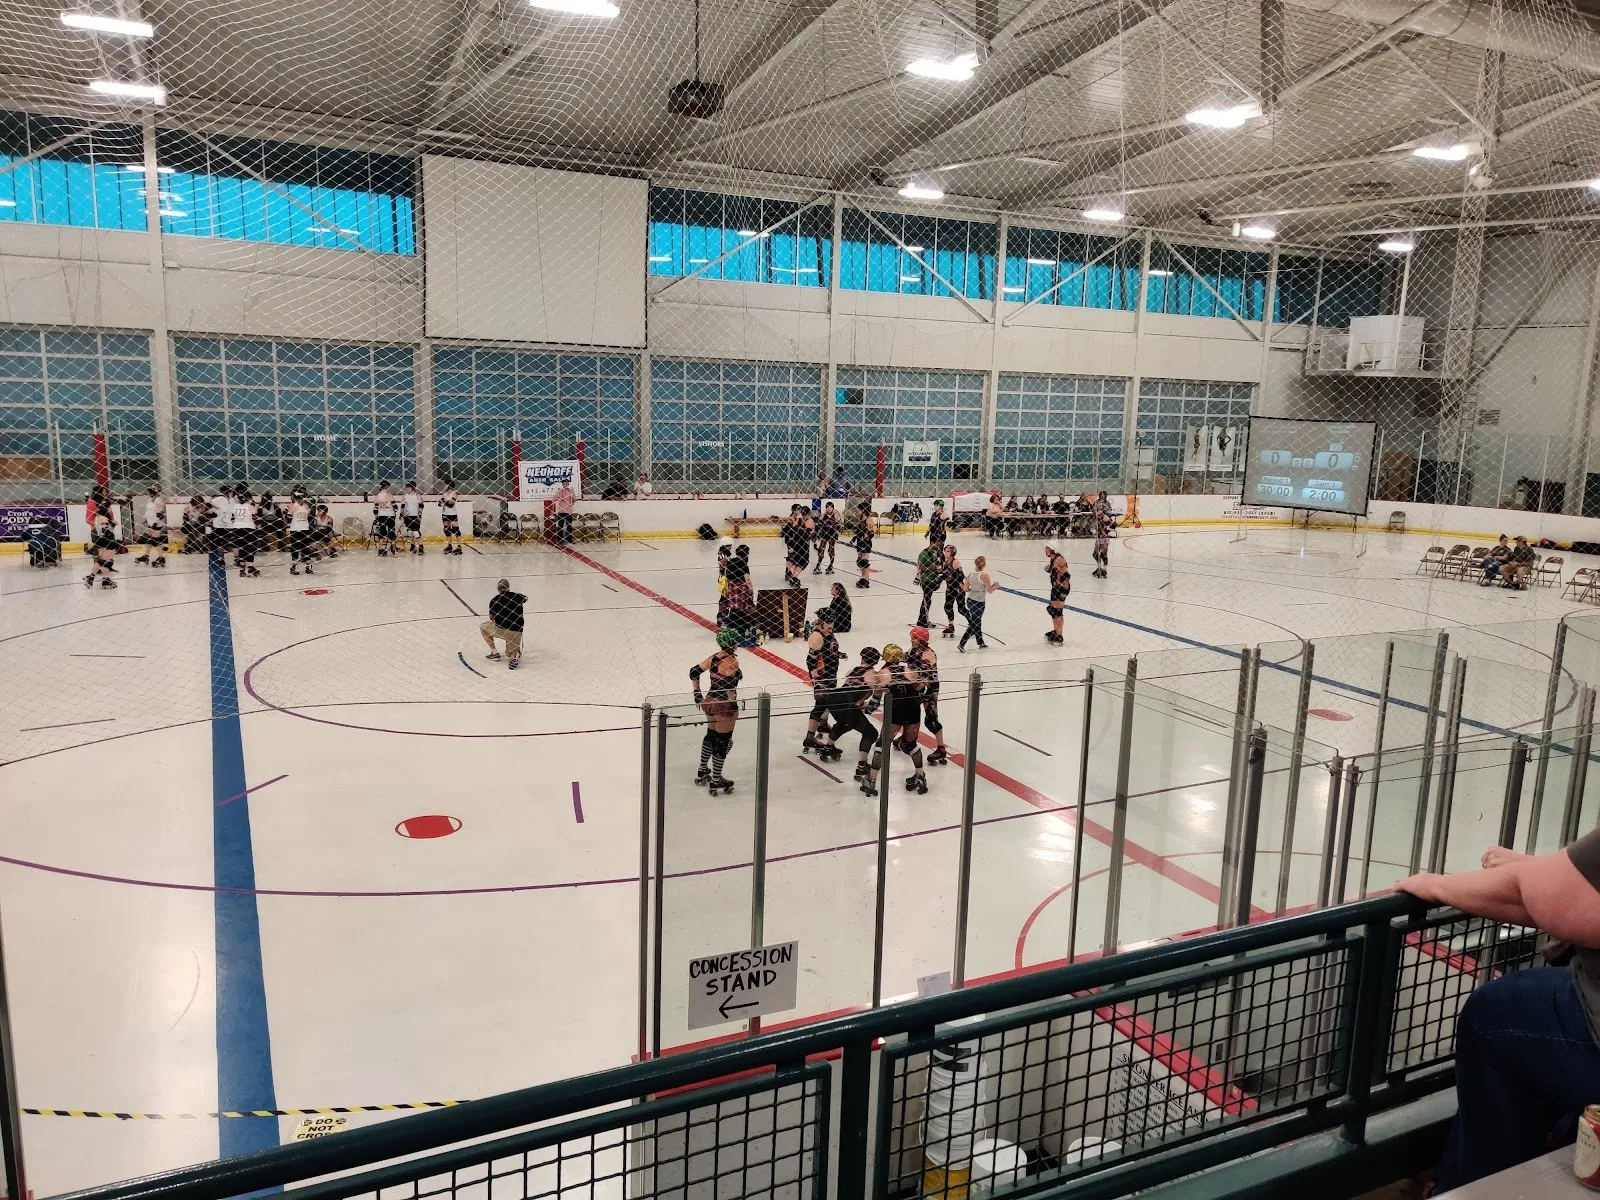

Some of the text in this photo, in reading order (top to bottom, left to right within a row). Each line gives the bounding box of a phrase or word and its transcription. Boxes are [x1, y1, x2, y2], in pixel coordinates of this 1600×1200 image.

[526, 466, 572, 477] NEUHOFF
[1260, 485, 1290, 497] 30:00
[1308, 489, 1337, 501] 2:00
[689, 943, 793, 979] CONCESSION
[706, 969, 777, 996] STAND
